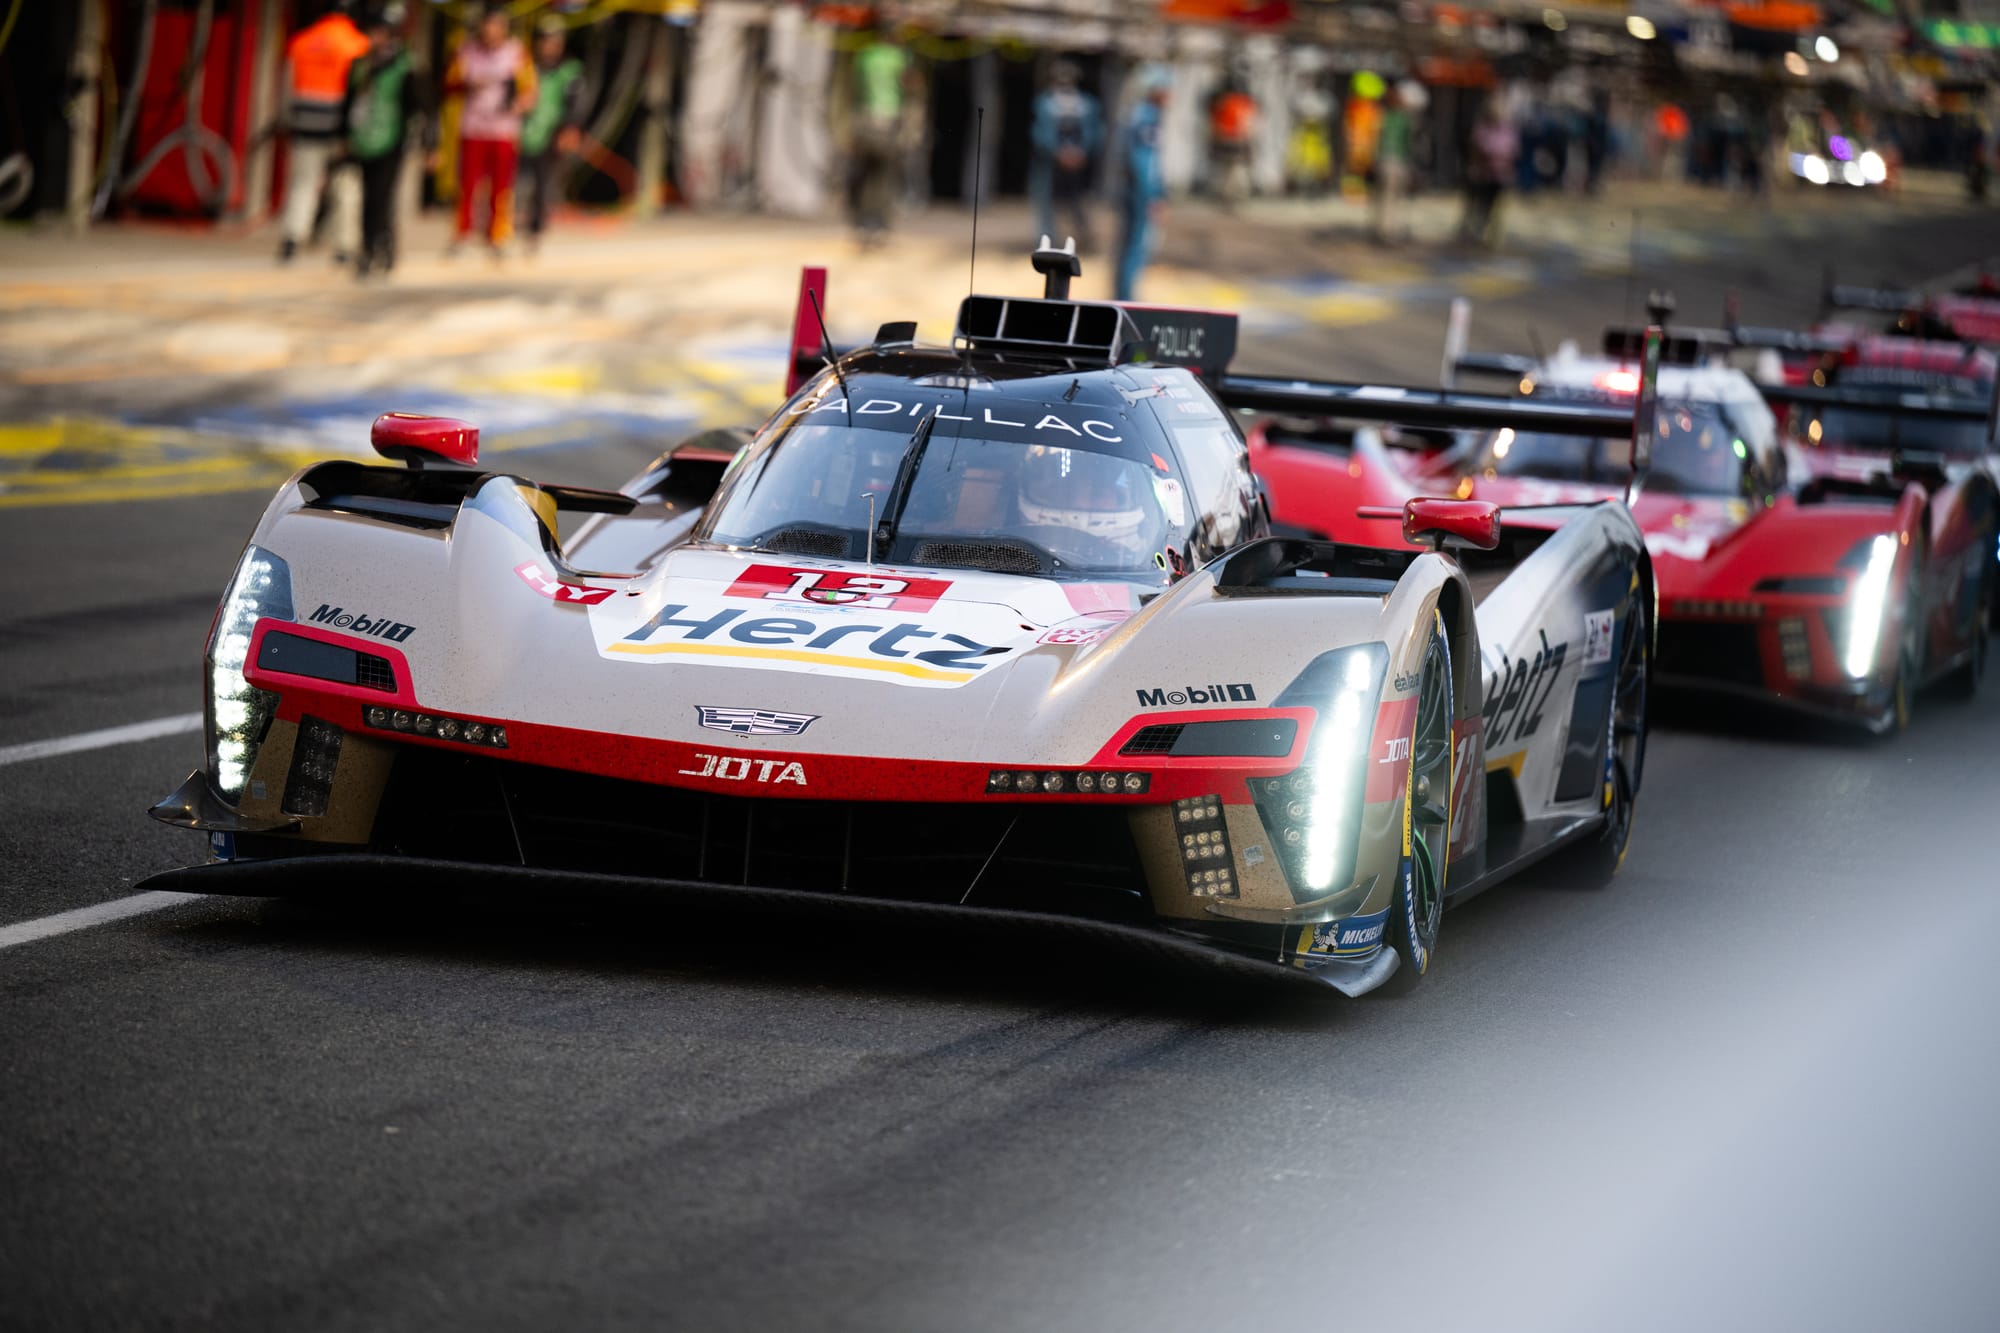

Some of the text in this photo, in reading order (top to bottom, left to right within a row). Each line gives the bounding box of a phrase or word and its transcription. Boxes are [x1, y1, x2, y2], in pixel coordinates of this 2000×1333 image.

[788, 397, 1124, 443] CADILLAC
[763, 572, 912, 609] 12
[623, 604, 1012, 671] Hertz
[1482, 628, 1568, 751] Hertz
[678, 753, 807, 785] JOTA
[1379, 736, 1410, 764] JOTA
